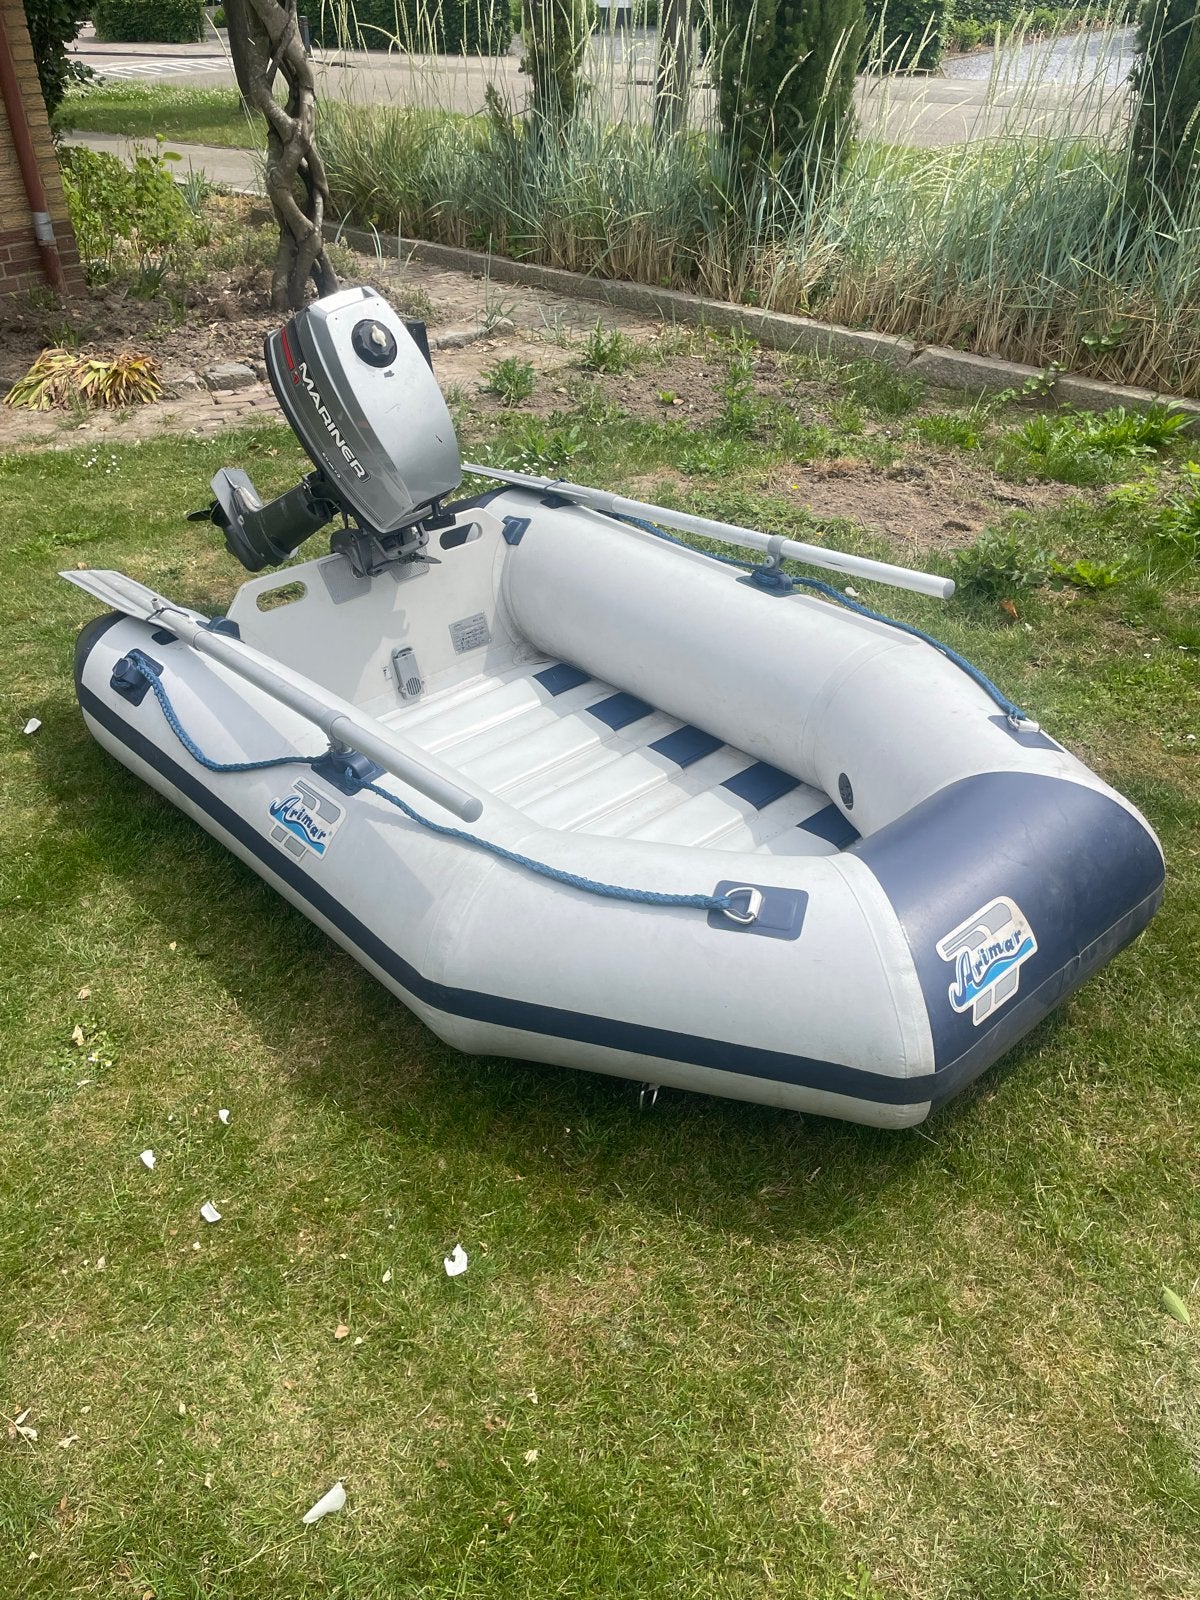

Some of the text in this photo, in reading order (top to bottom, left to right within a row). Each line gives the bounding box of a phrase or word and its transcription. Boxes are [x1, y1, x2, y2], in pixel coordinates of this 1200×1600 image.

[298, 362, 366, 479] MARINER
[269, 796, 327, 840] Arimar
[950, 930, 1022, 1008] Arimar
